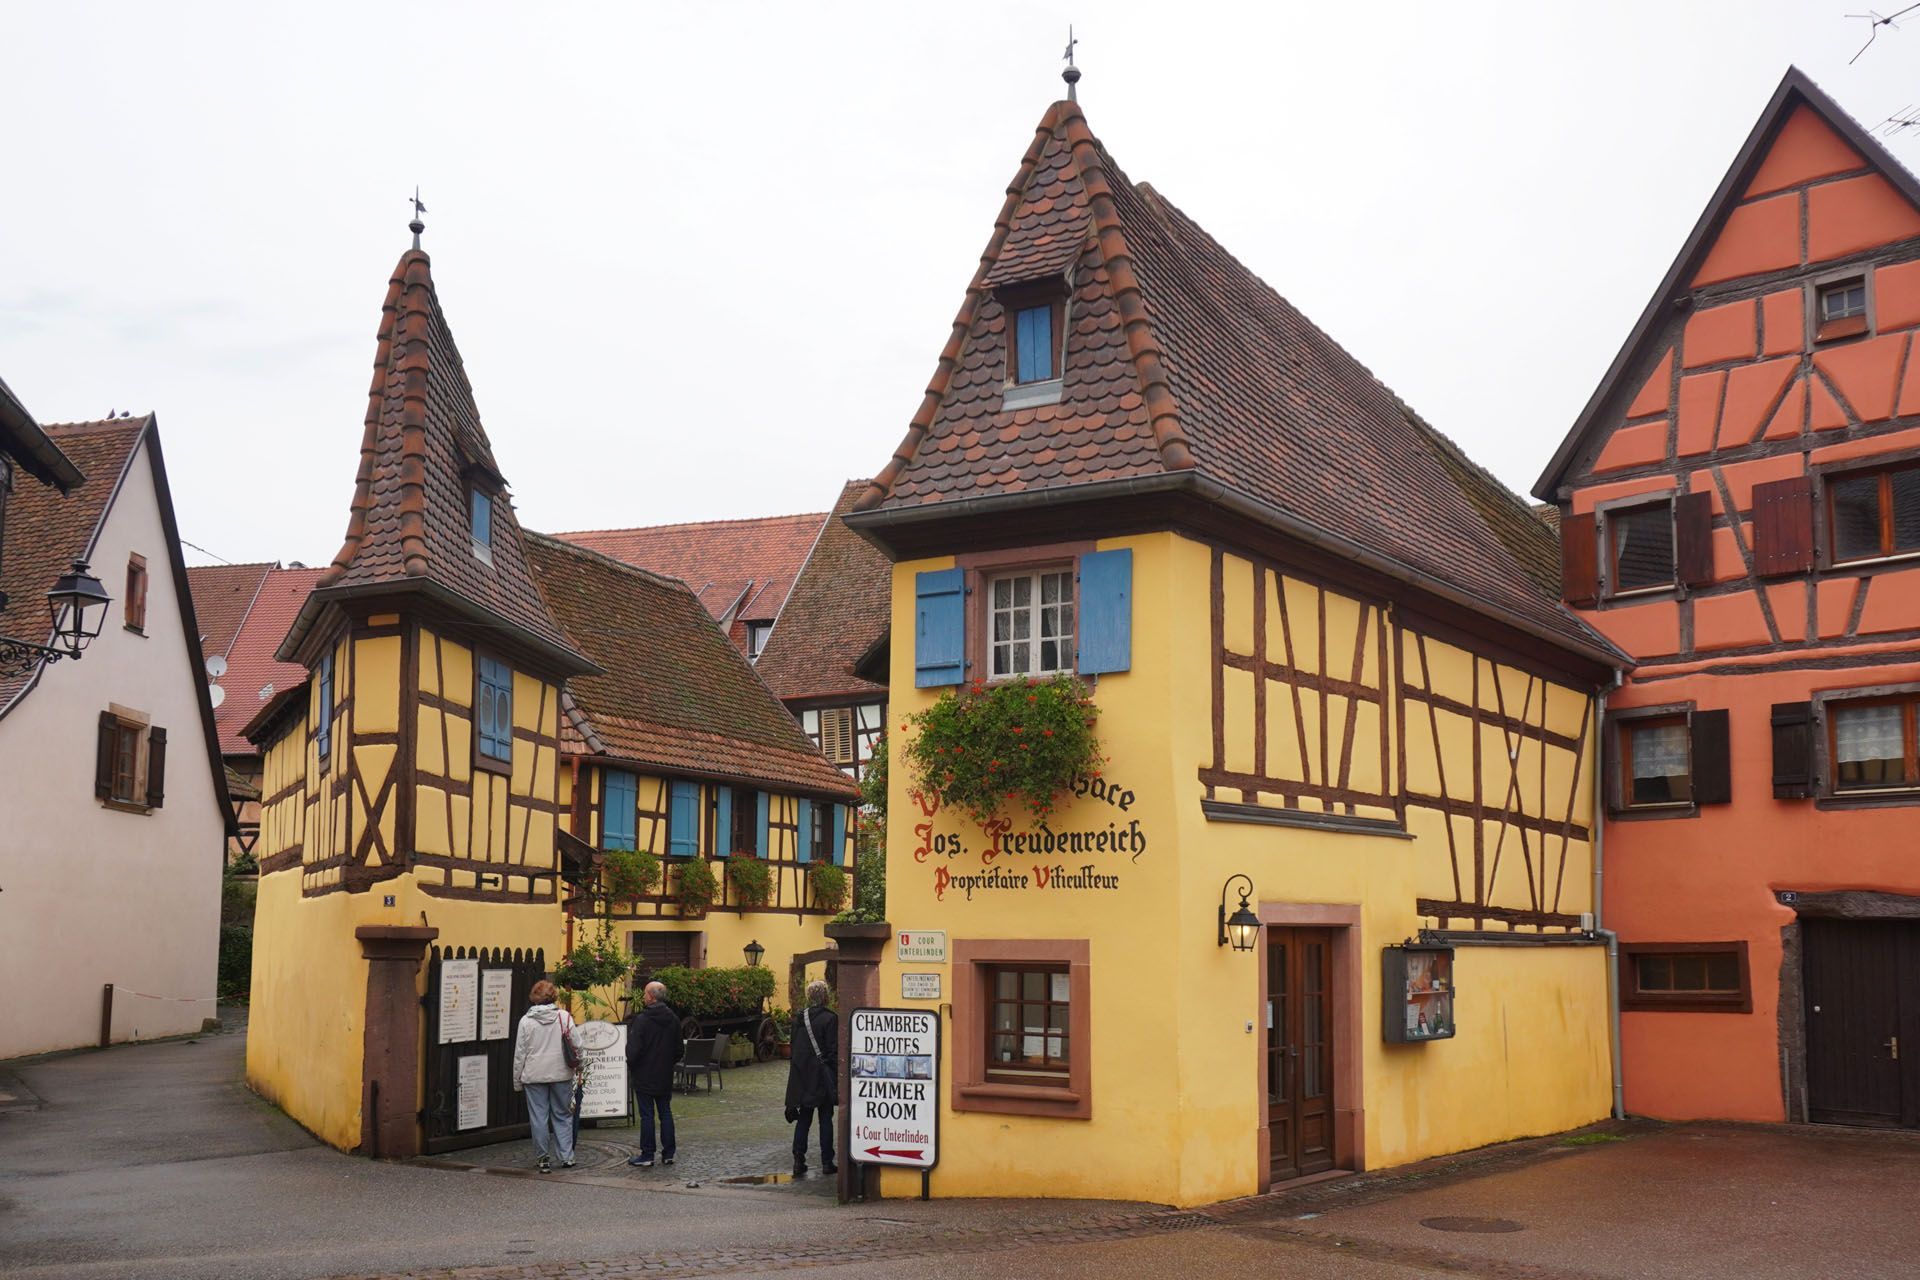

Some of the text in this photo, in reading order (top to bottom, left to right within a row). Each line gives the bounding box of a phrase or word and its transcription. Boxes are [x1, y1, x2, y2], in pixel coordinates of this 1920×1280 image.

[980, 816, 1147, 865] Freudenreich
[934, 864, 1119, 902] Propriétaire Viticulteur
[918, 936, 935, 945] COUR
[900, 947, 944, 956] UNTERLINDEN
[855, 1014, 929, 1034] CHAMBRES
[864, 1036, 920, 1055] D'HOTES
[586, 1055, 624, 1063] DENREICH
[858, 1080, 926, 1101] ZIMMER
[866, 1101, 917, 1121] ROOM
[855, 1125, 929, 1144] 4 Cour Unterlinden
